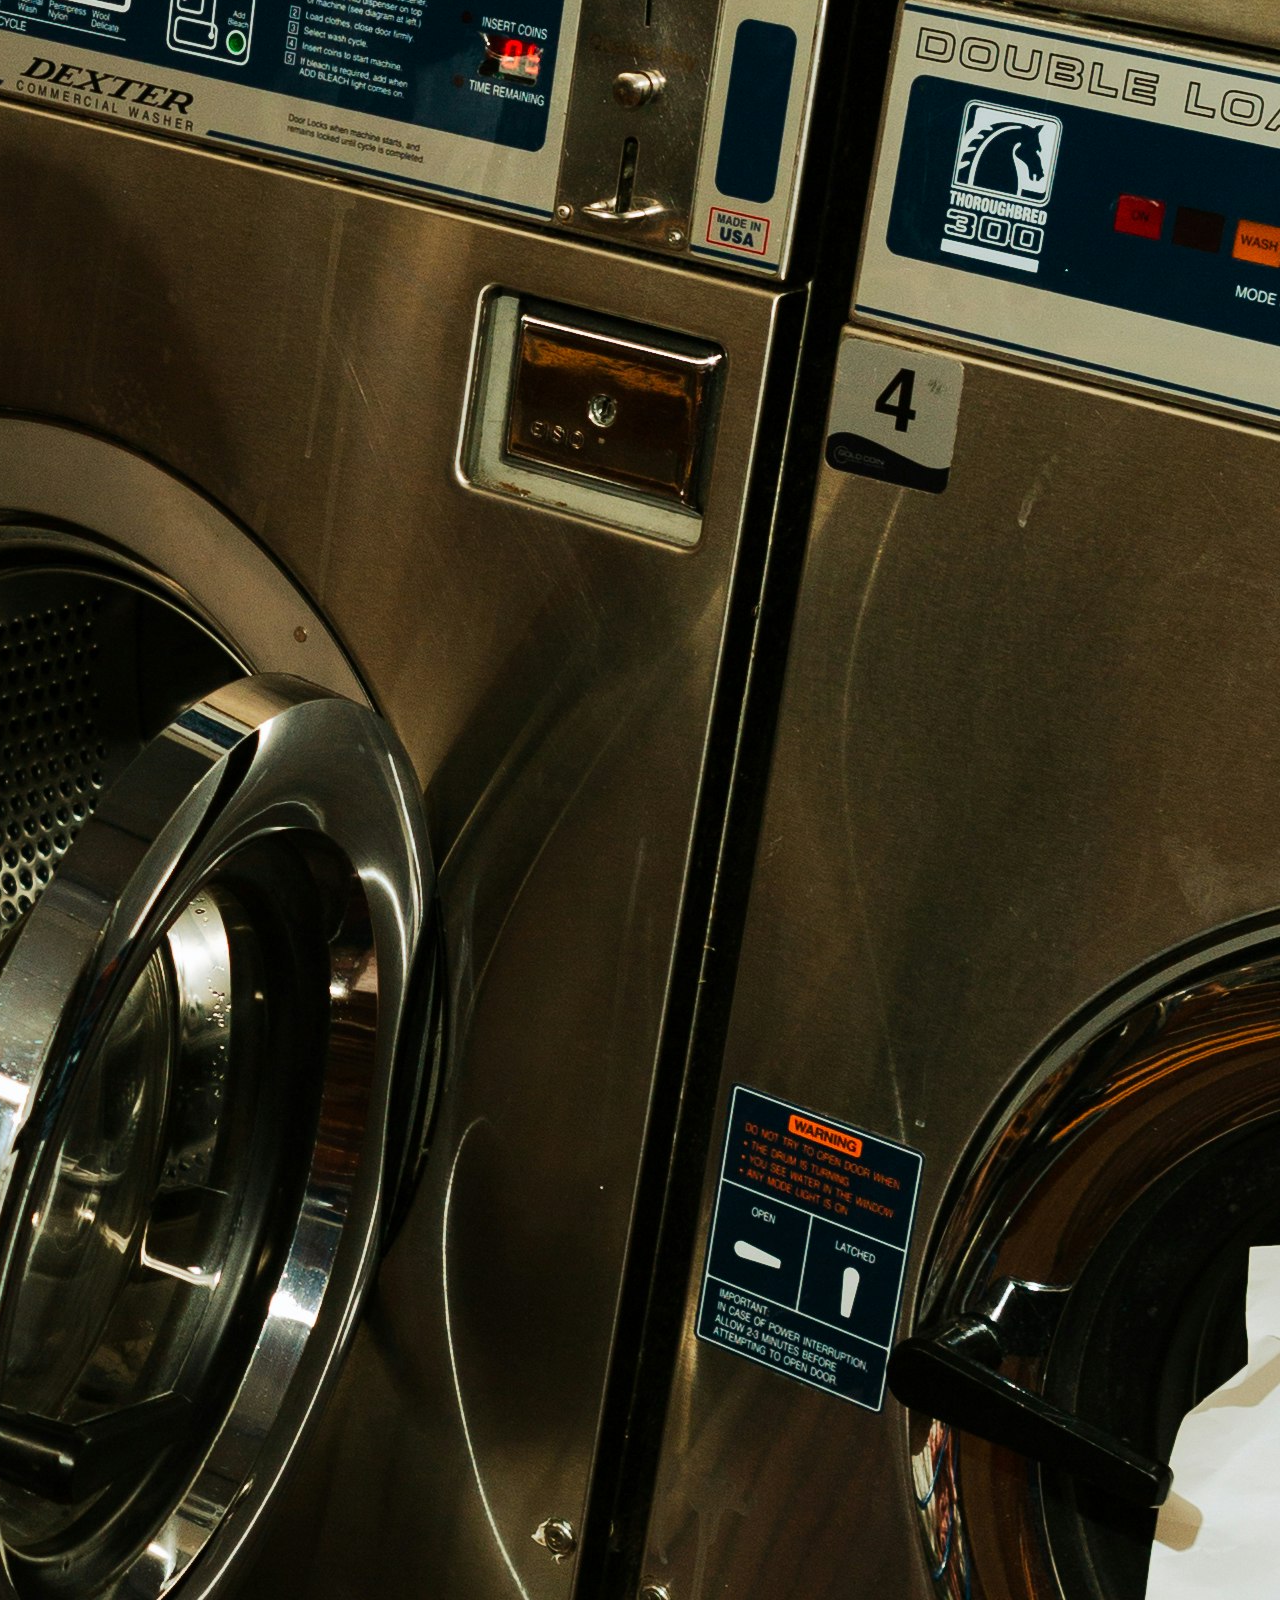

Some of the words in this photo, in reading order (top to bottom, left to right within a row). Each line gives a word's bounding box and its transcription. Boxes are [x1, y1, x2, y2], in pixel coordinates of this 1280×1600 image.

[91, 19, 120, 33] Delicate
[304, 26, 326, 39] Select
[482, 16, 516, 33] INSERT
[517, 24, 548, 40] COINS
[302, 42, 322, 53] Insert
[323, 47, 342, 58] coins
[307, 57, 330, 70] bleach
[20, 56, 194, 115] DEXTER
[299, 67, 316, 78] ADD
[318, 72, 349, 85] BLEACH
[368, 84, 391, 95] comes
[469, 79, 491, 95] TIME
[492, 84, 545, 106] REMAINING
[915, 26, 1160, 107] DOUBLE
[1183, 82, 1280, 132] LO
[16, 80, 118, 113] COMMERCIAL
[128, 106, 194, 132] WASHER
[287, 125, 315, 138] remains
[316, 132, 340, 143] locked
[350, 129, 381, 142] machine
[949, 189, 1048, 226] THOROUGHBRED
[717, 213, 747, 229] MADE
[750, 221, 761, 232] IN
[720, 227, 754, 247] USA
[944, 208, 1044, 254] 300
[1241, 234, 1279, 252] WASH
[1235, 284, 1277, 306] MODE
[875, 367, 916, 433] 4
[794, 1120, 858, 1153] WARNING
[751, 1140, 768, 1155] THE
[770, 1148, 797, 1167] DRUM
[810, 1163, 850, 1188] TURNING
[761, 1128, 779, 1143] NOT
[782, 1135, 799, 1150] TRY
[816, 1149, 841, 1167] OPEN
[843, 1160, 870, 1178] DOOR
[873, 1171, 901, 1191] WHEN
[746, 1168, 764, 1182] ANY
[767, 1176, 793, 1194] MODE
[795, 1186, 821, 1204] LIGHT
[834, 1202, 849, 1216] ON
[749, 1154, 767, 1170] YOU
[770, 1163, 787, 1176] SEE
[790, 1170, 820, 1189] WATER
[835, 1187, 853, 1203] THE
[855, 1193, 894, 1218] WINDOW
[751, 1206, 776, 1224] OPEN
[835, 1240, 876, 1265] LATCHED
[719, 1287, 770, 1317] IMPORTANT:
[715, 1314, 746, 1334] ALLOW
[746, 1327, 759, 1339] 2-3
[761, 1332, 800, 1357] MINUTES
[802, 1350, 837, 1373] BEFORE
[717, 1300, 726, 1312] IN
[728, 1305, 751, 1322] CASE
[753, 1315, 766, 1327] OF
[768, 1322, 801, 1342] POWER
[802, 1336, 868, 1373] INTERRUPTION,
[713, 1326, 766, 1356] ATTEMPTING
[769, 1348, 781, 1362] TO
[783, 1356, 808, 1374] OPEN
[810, 1366, 838, 1386] DOOR.
